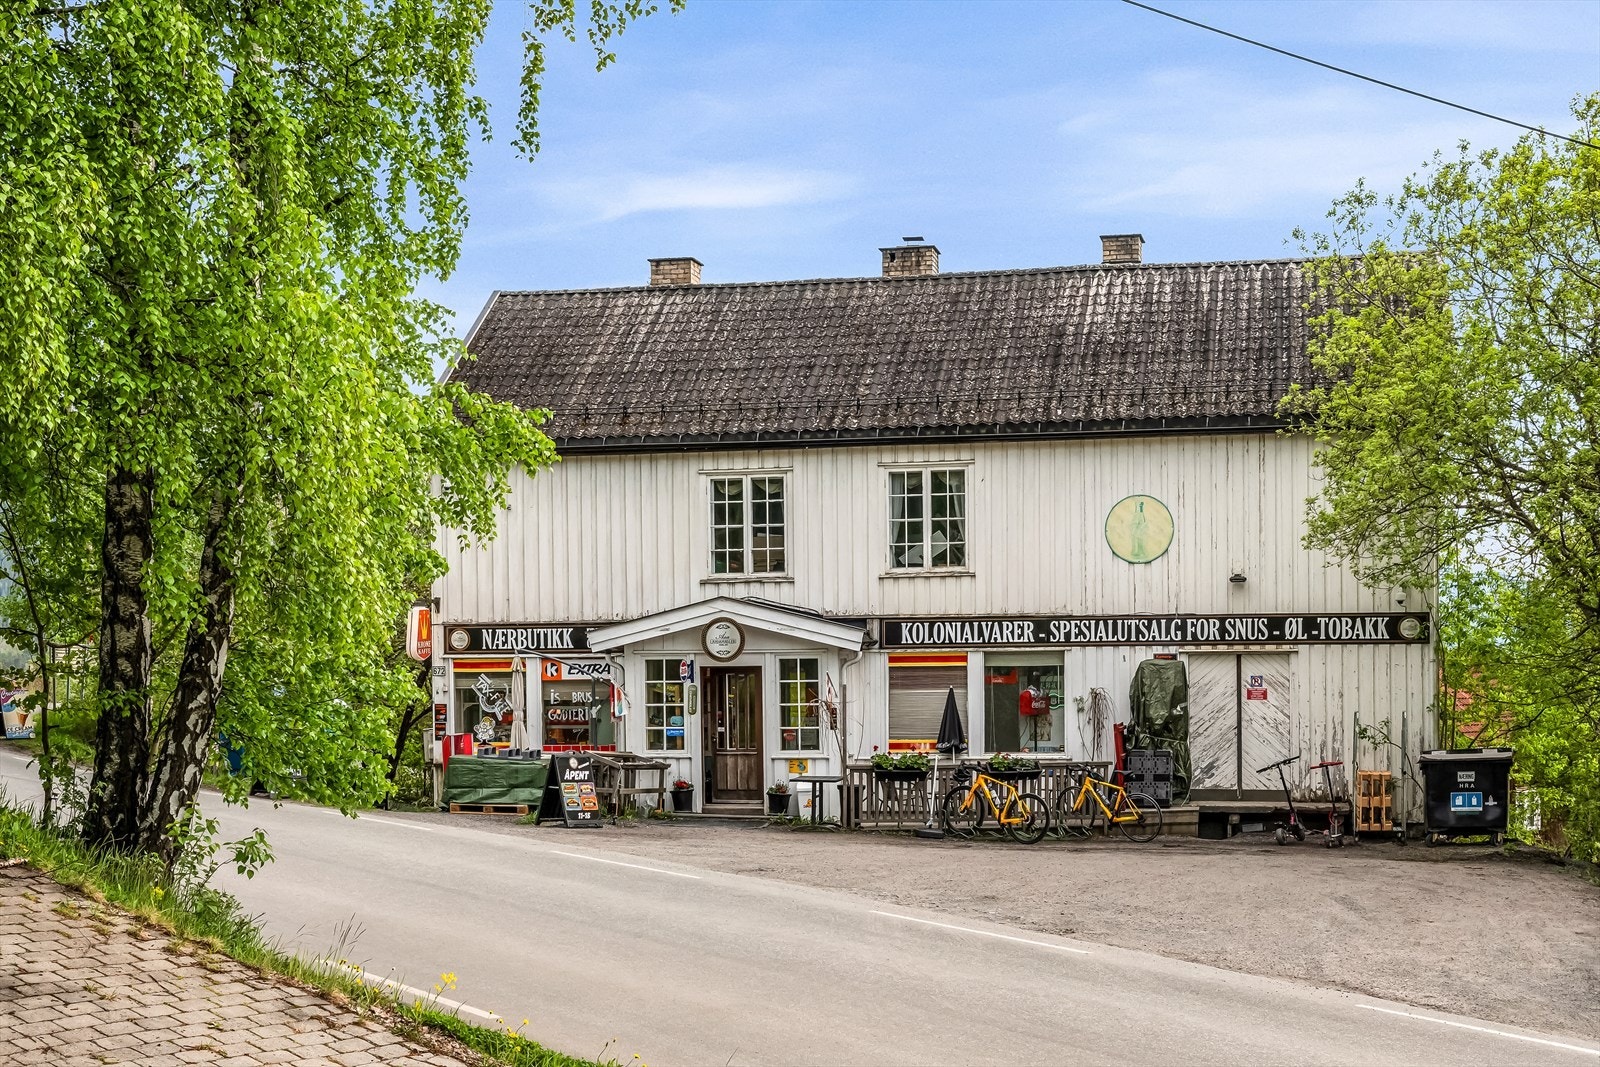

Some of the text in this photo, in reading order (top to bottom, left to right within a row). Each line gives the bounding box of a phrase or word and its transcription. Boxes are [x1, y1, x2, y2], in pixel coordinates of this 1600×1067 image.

[900, 621, 1035, 644] KOLONIALVARER
[1049, 618, 1182, 642] SPESIALUTSALG
[1185, 618, 1221, 641] FOR
[1225, 618, 1269, 641] SNUS
[1284, 617, 1308, 640] ØL
[481, 628, 574, 650] NÆRBUTIKK
[567, 662, 612, 675] EXTRA
[571, 691, 593, 703] BRUS
[564, 768, 590, 780] ÅPENT
